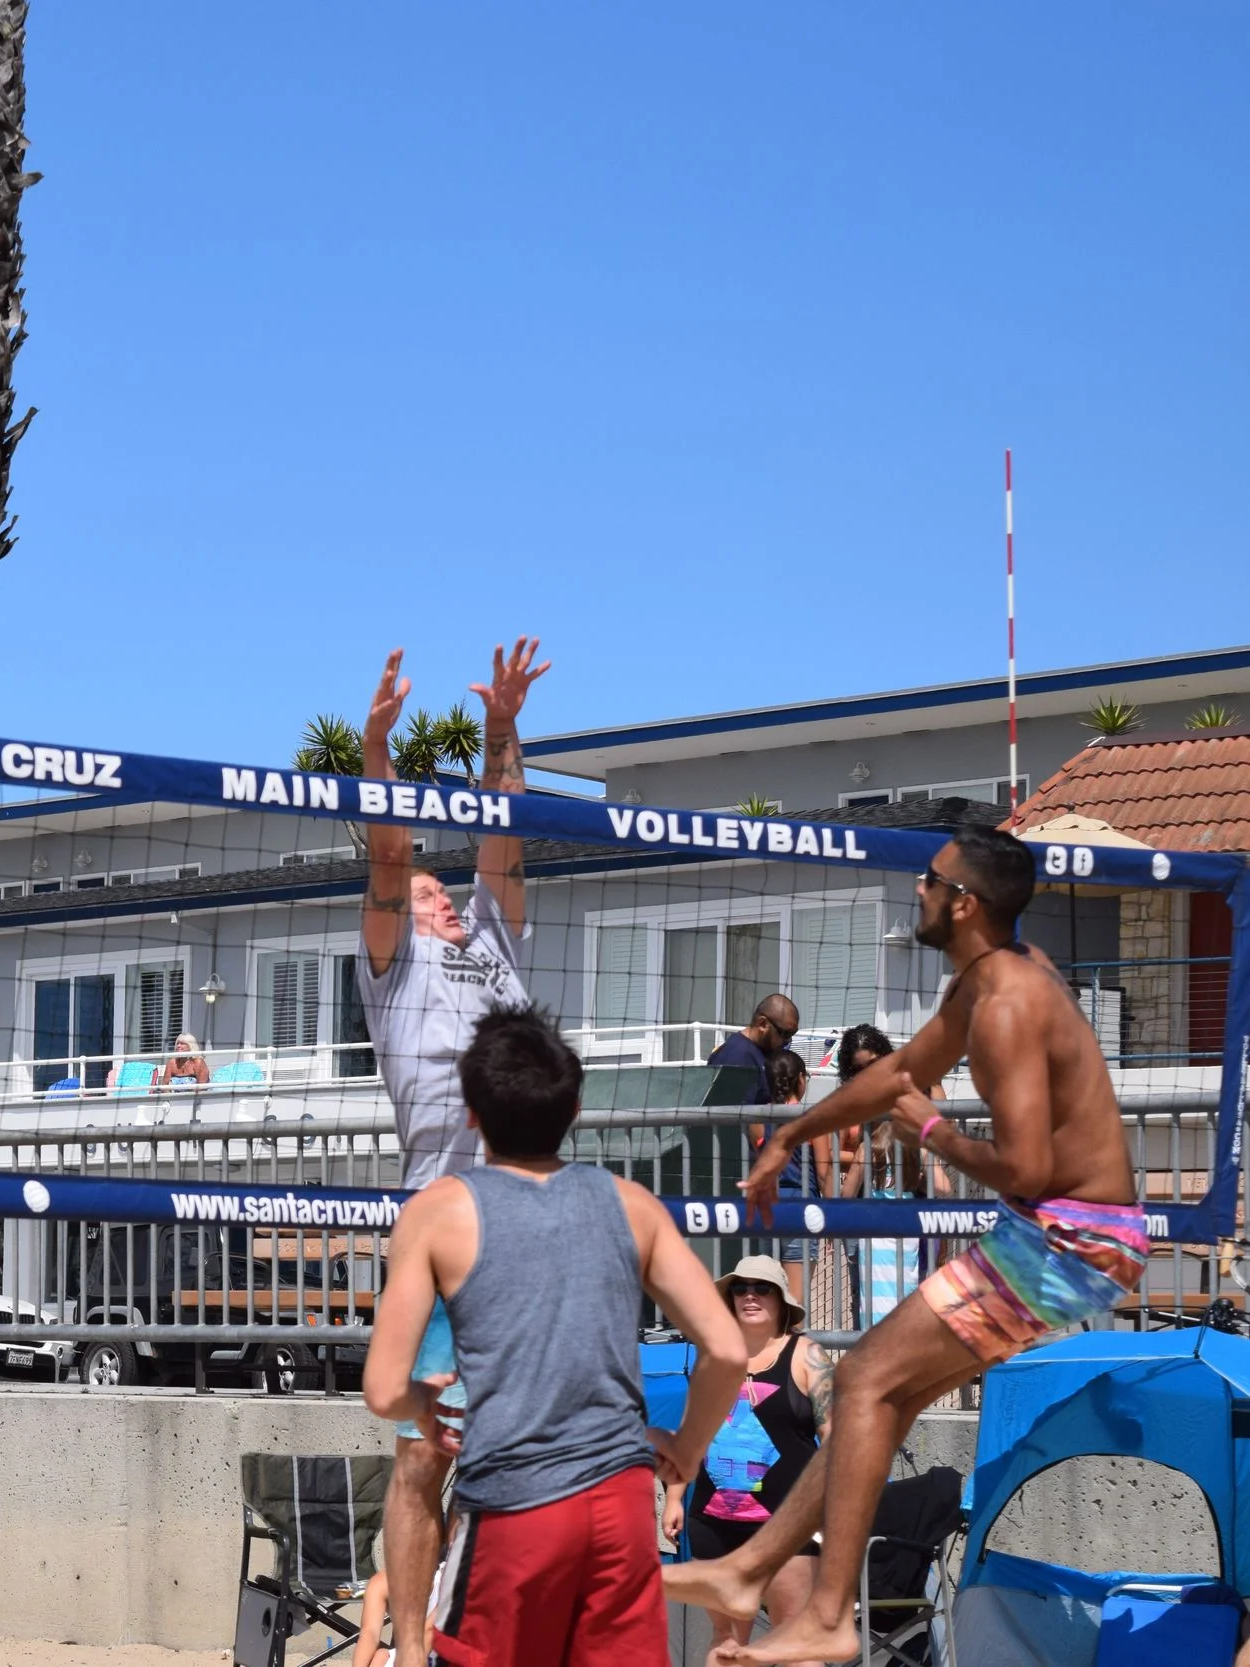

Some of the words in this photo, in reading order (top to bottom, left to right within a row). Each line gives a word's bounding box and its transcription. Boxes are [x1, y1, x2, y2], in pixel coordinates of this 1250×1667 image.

[1, 743, 122, 788] CRUZ
[221, 767, 339, 810] MAIN
[358, 781, 510, 827] BEACH
[607, 807, 867, 860] VOLLEYBALL
[170, 1192, 405, 1227] www.santacruzwh
